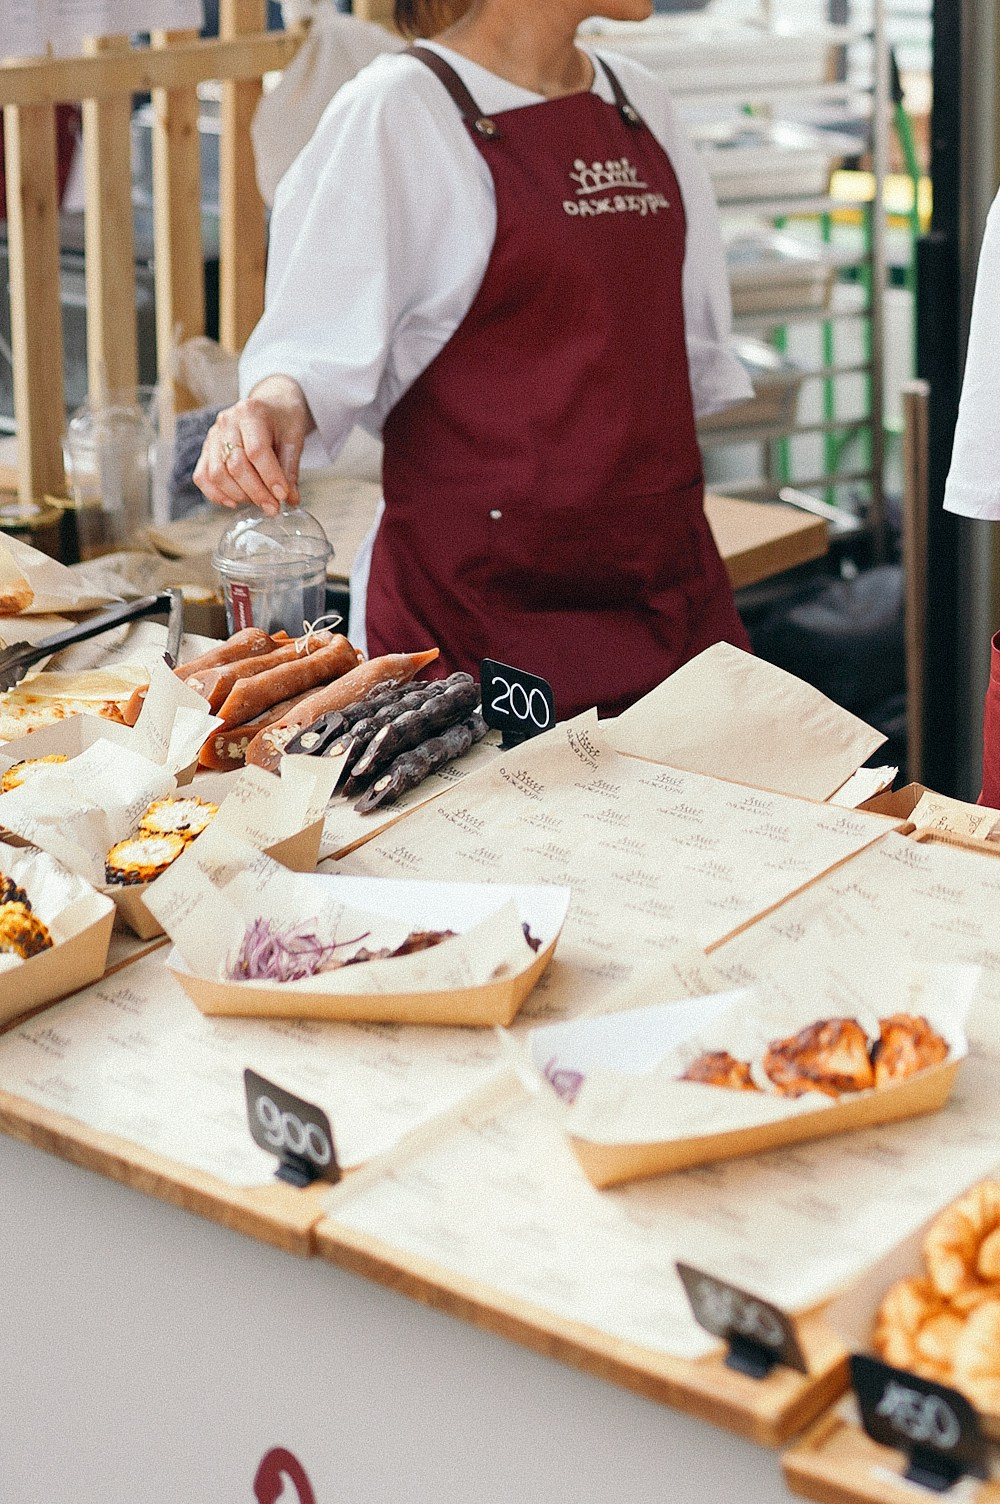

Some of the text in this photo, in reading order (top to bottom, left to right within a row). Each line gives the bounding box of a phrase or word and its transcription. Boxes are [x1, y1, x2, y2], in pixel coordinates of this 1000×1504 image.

[562, 192, 670, 218] оджахури
[491, 676, 550, 728] 200
[566, 728, 599, 773] оджахури
[255, 1095, 332, 1166] 900
